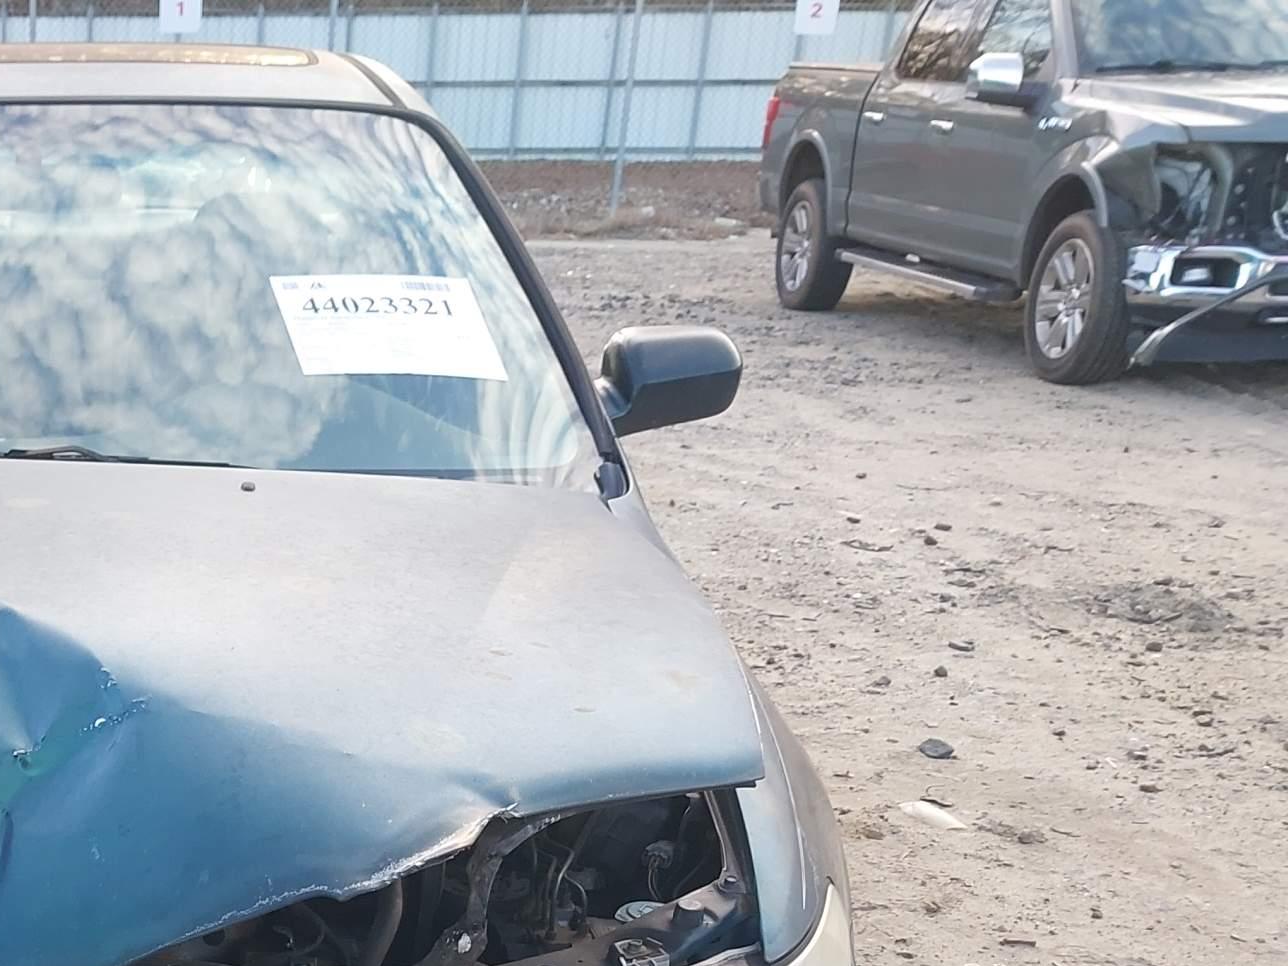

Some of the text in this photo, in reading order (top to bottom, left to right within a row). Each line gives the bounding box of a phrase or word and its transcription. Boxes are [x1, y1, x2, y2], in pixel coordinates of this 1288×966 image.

[176, 1, 184, 16] 1
[810, 2, 823, 18] 2
[302, 296, 453, 317] 44023321
